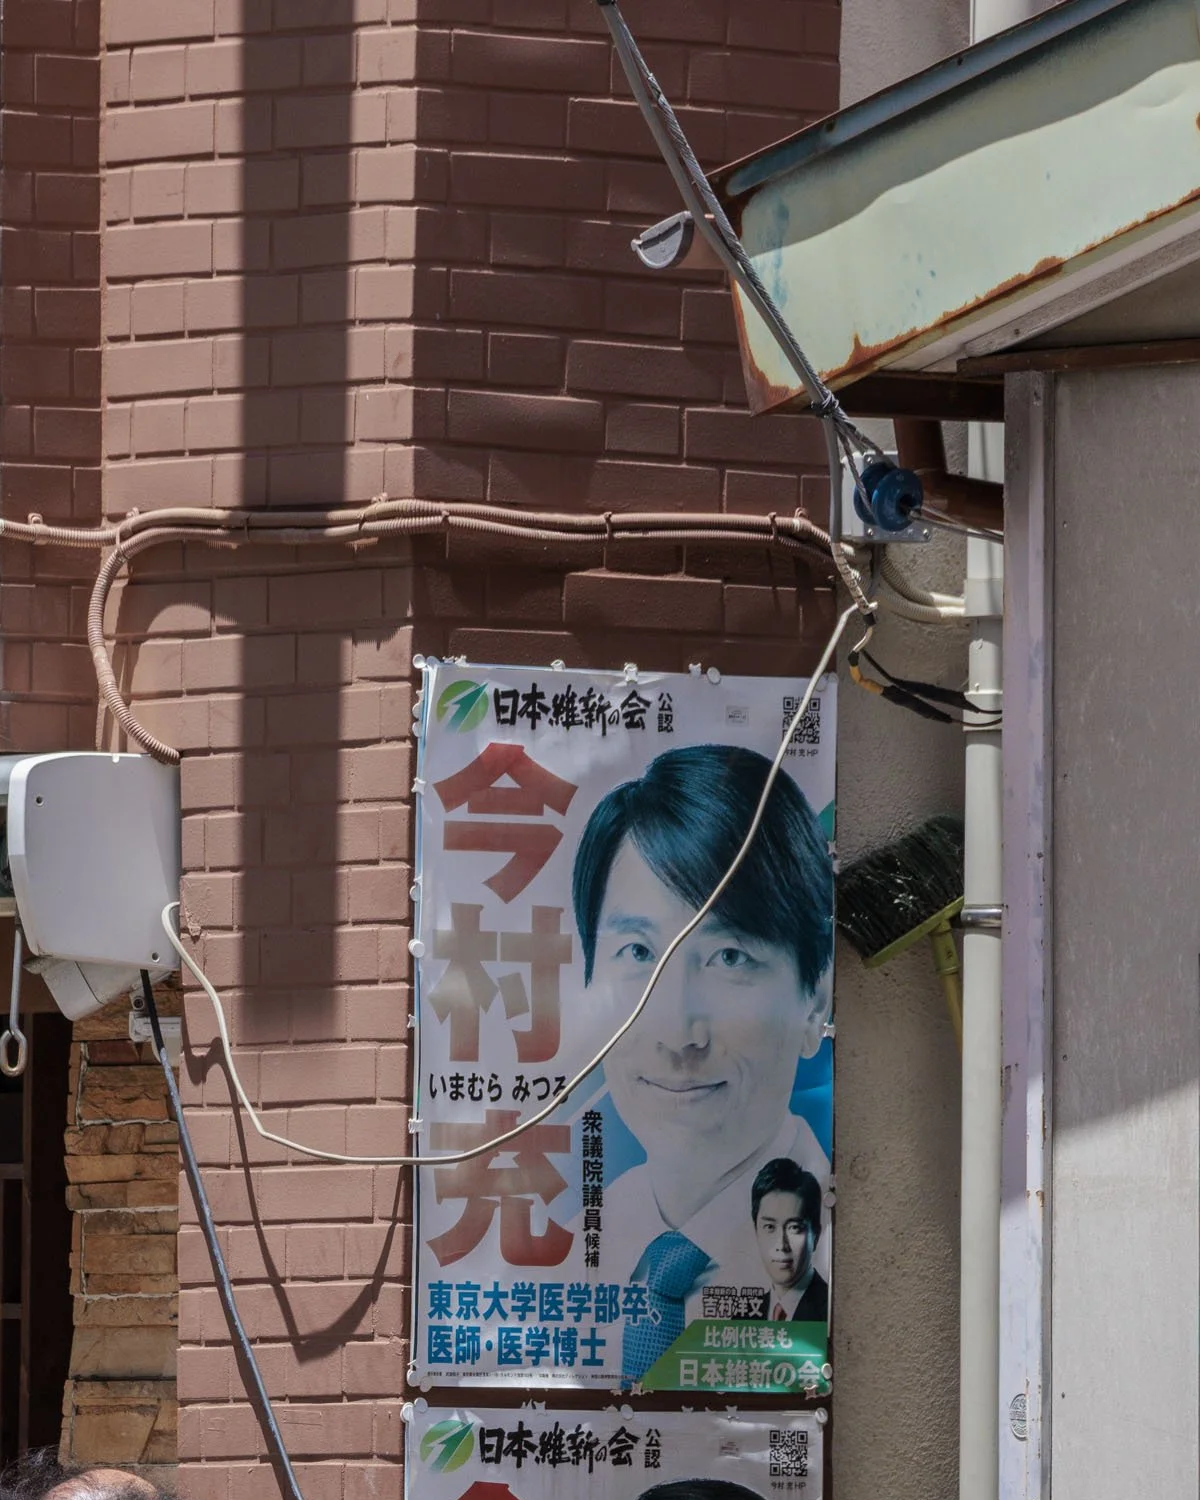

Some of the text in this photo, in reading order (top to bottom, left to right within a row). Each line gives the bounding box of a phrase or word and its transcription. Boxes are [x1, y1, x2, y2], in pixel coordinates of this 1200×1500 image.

[493, 683, 675, 737] 日本維新の会 公認
[427, 741, 579, 1063] 今村
[429, 1072, 571, 1105] いまむら みつる
[425, 1109, 575, 1267] 充
[581, 1109, 604, 1269] 衆議院議員候補
[703, 1296, 764, 1318] 吉村洋文
[427, 1328, 607, 1367] 医師・医学博士
[703, 1326, 794, 1350] 比例代表も
[678, 1358, 822, 1389] 日本維新の会
[478, 1420, 662, 1474] 日本維新の会 公認
